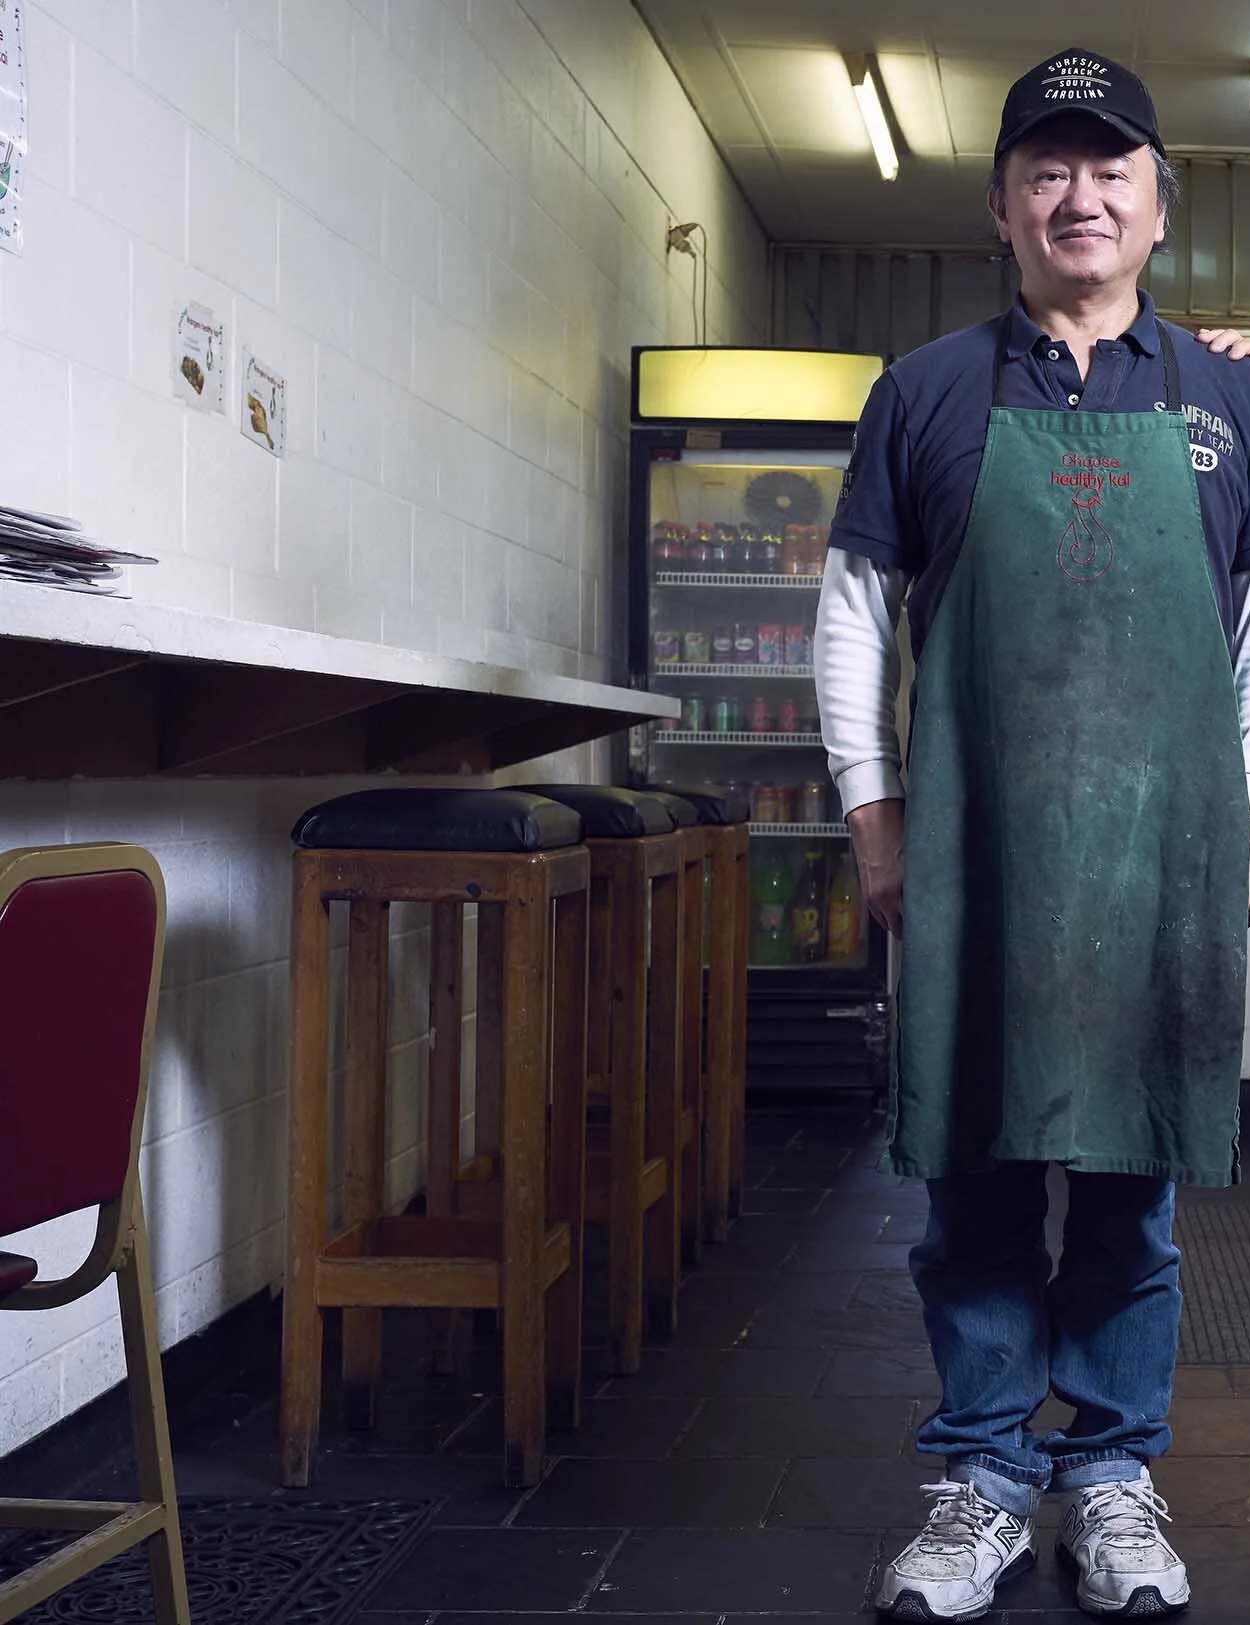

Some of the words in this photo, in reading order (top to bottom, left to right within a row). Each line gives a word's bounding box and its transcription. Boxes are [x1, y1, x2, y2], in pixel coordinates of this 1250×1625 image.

[1047, 57, 1108, 75] SURFSIDE
[1060, 67, 1093, 76] BEACH
[1059, 79, 1092, 88] SOUTH
[1044, 88, 1105, 100] CAROLINA
[1153, 401, 1234, 446] SNFRAN
[1207, 433, 1234, 457] TEAM
[1062, 453, 1120, 469] Choose
[1051, 471, 1104, 492] healthy
